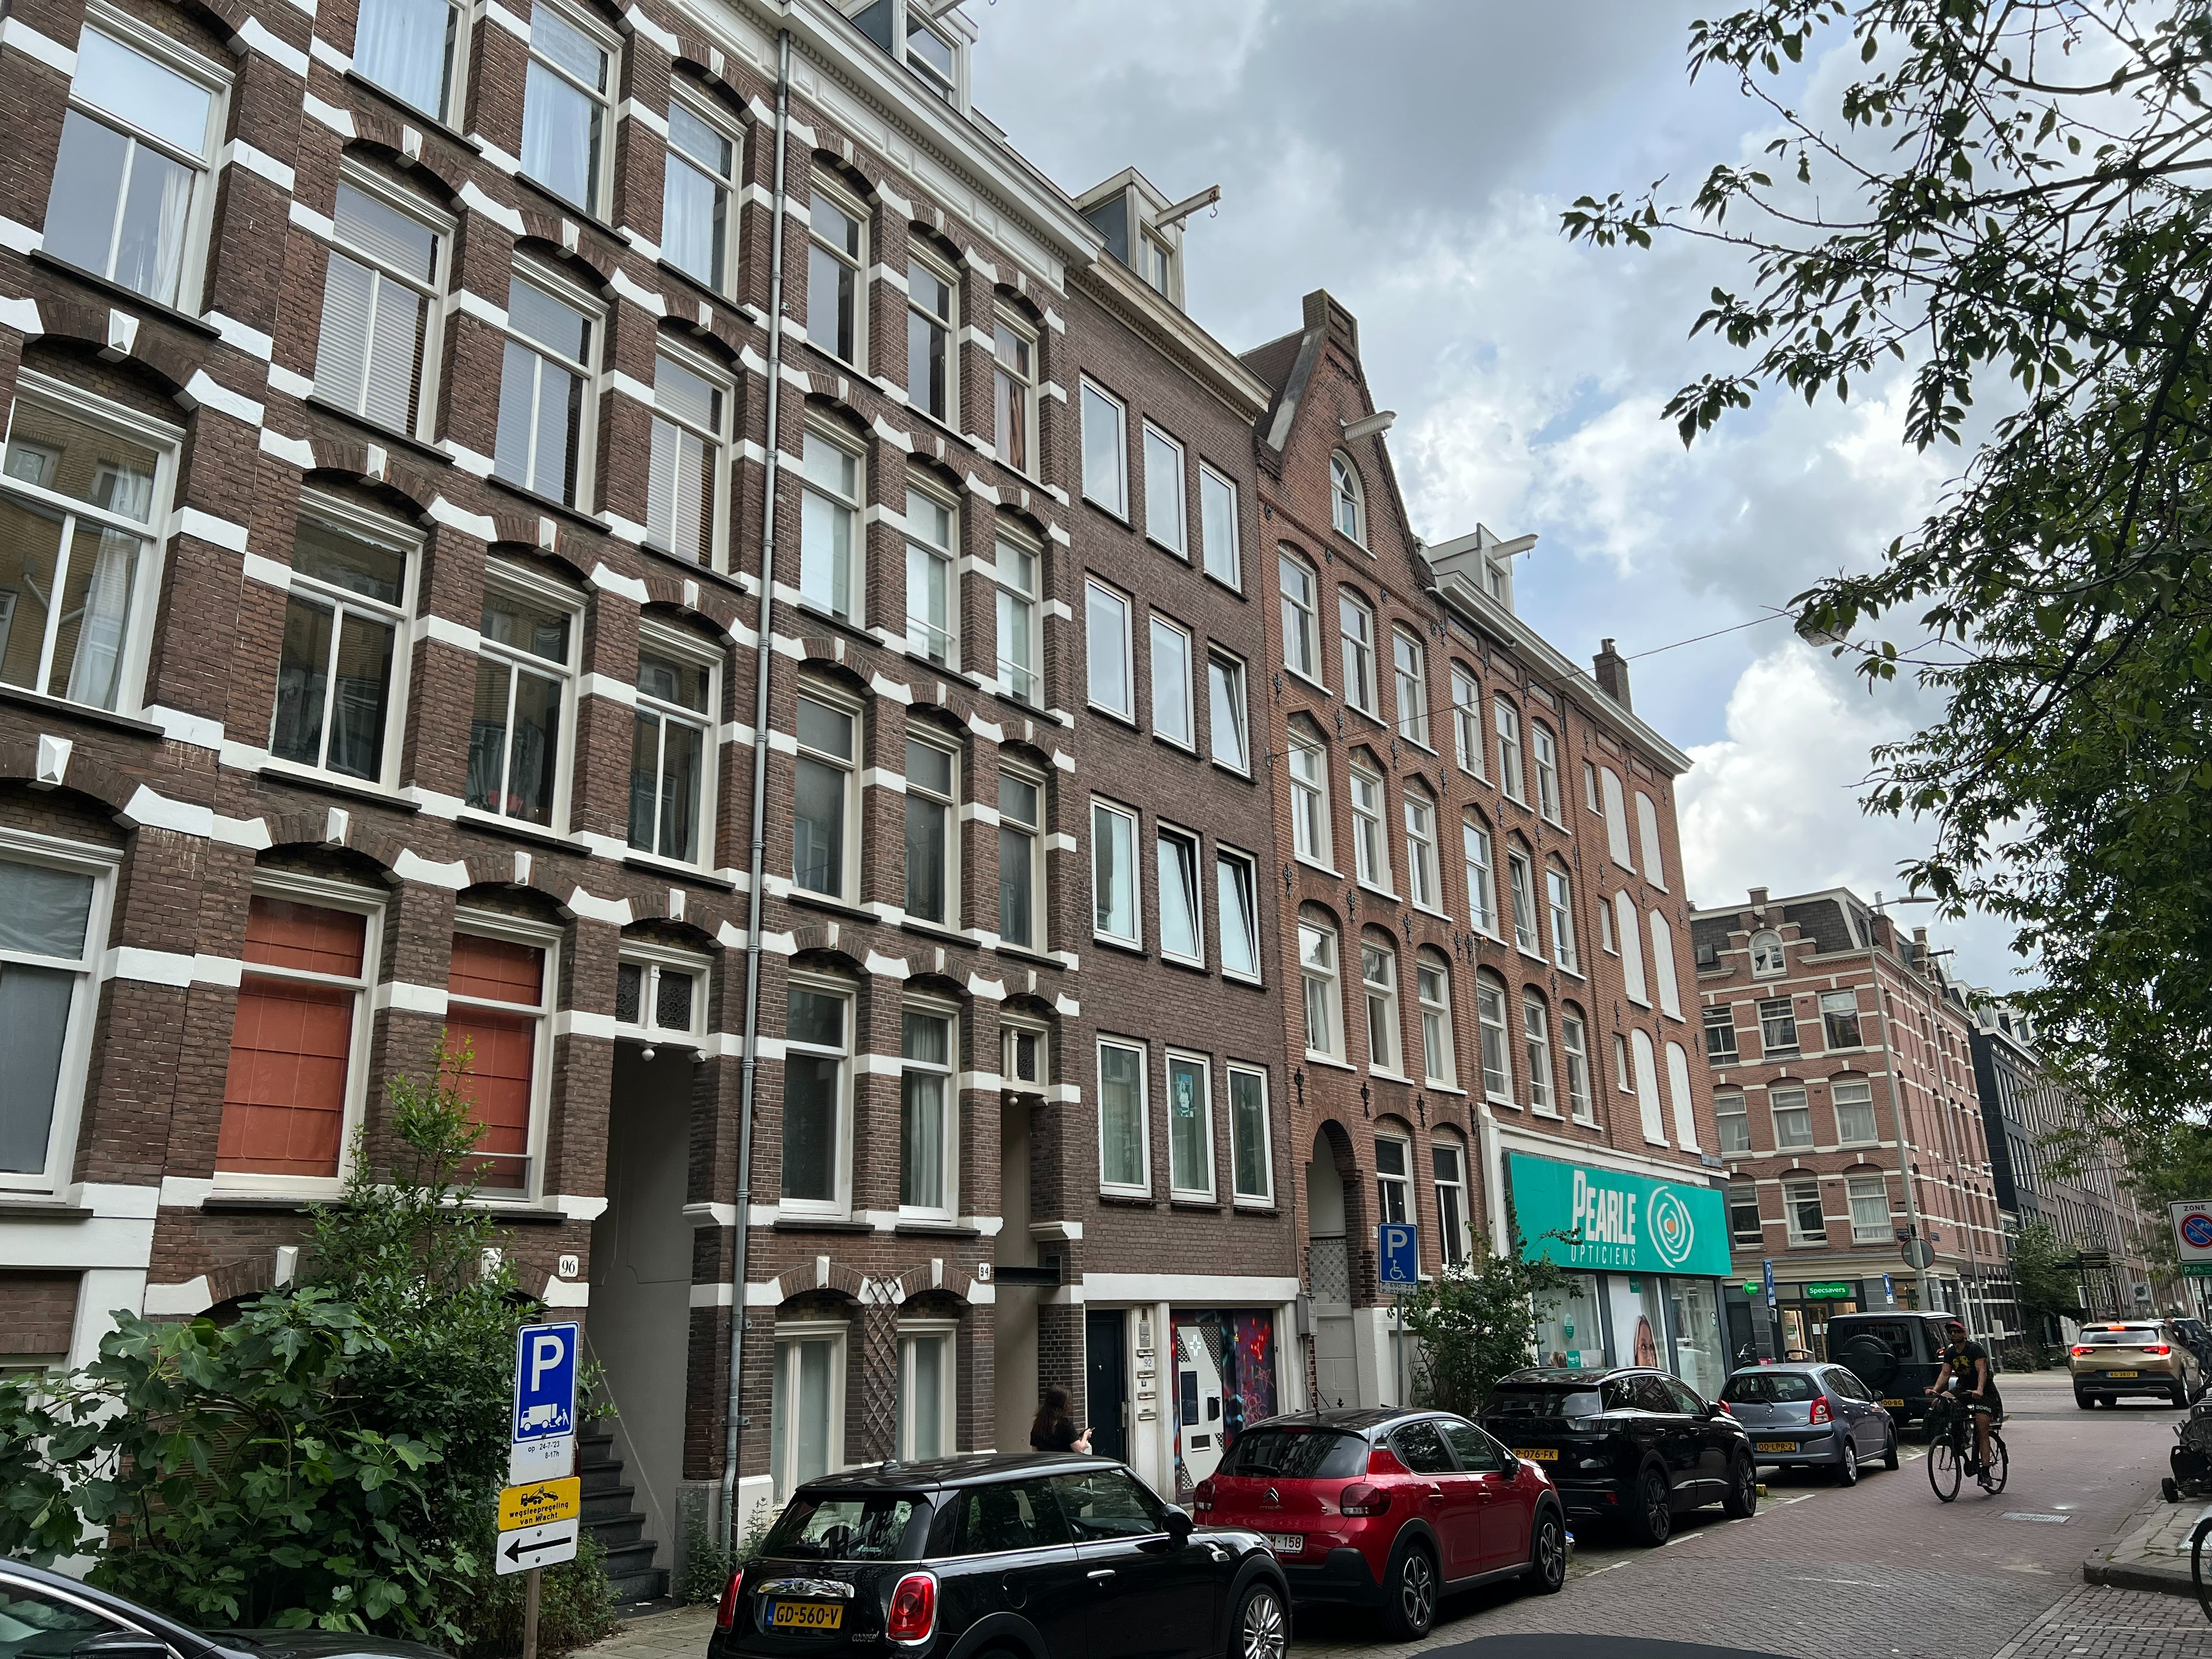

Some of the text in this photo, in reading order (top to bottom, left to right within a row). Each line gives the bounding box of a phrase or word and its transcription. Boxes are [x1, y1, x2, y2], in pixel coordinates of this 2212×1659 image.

[1572, 1170, 1636, 1245] PEARLE
[1387, 1229, 1408, 1258] P
[1571, 1245, 1635, 1266] OPTICIENS
[562, 1260, 575, 1274] 96
[980, 1267, 989, 1277] 94
[1767, 1264, 1771, 1283] P
[531, 1335, 564, 1392] P
[1144, 1358, 1152, 1367] 92
[545, 1451, 560, 1459] 8-17h
[1516, 1450, 1554, 1459] P-076-FK
[509, 1502, 569, 1518] wegsleepregeling
[776, 1606, 839, 1625] GD-560-V
